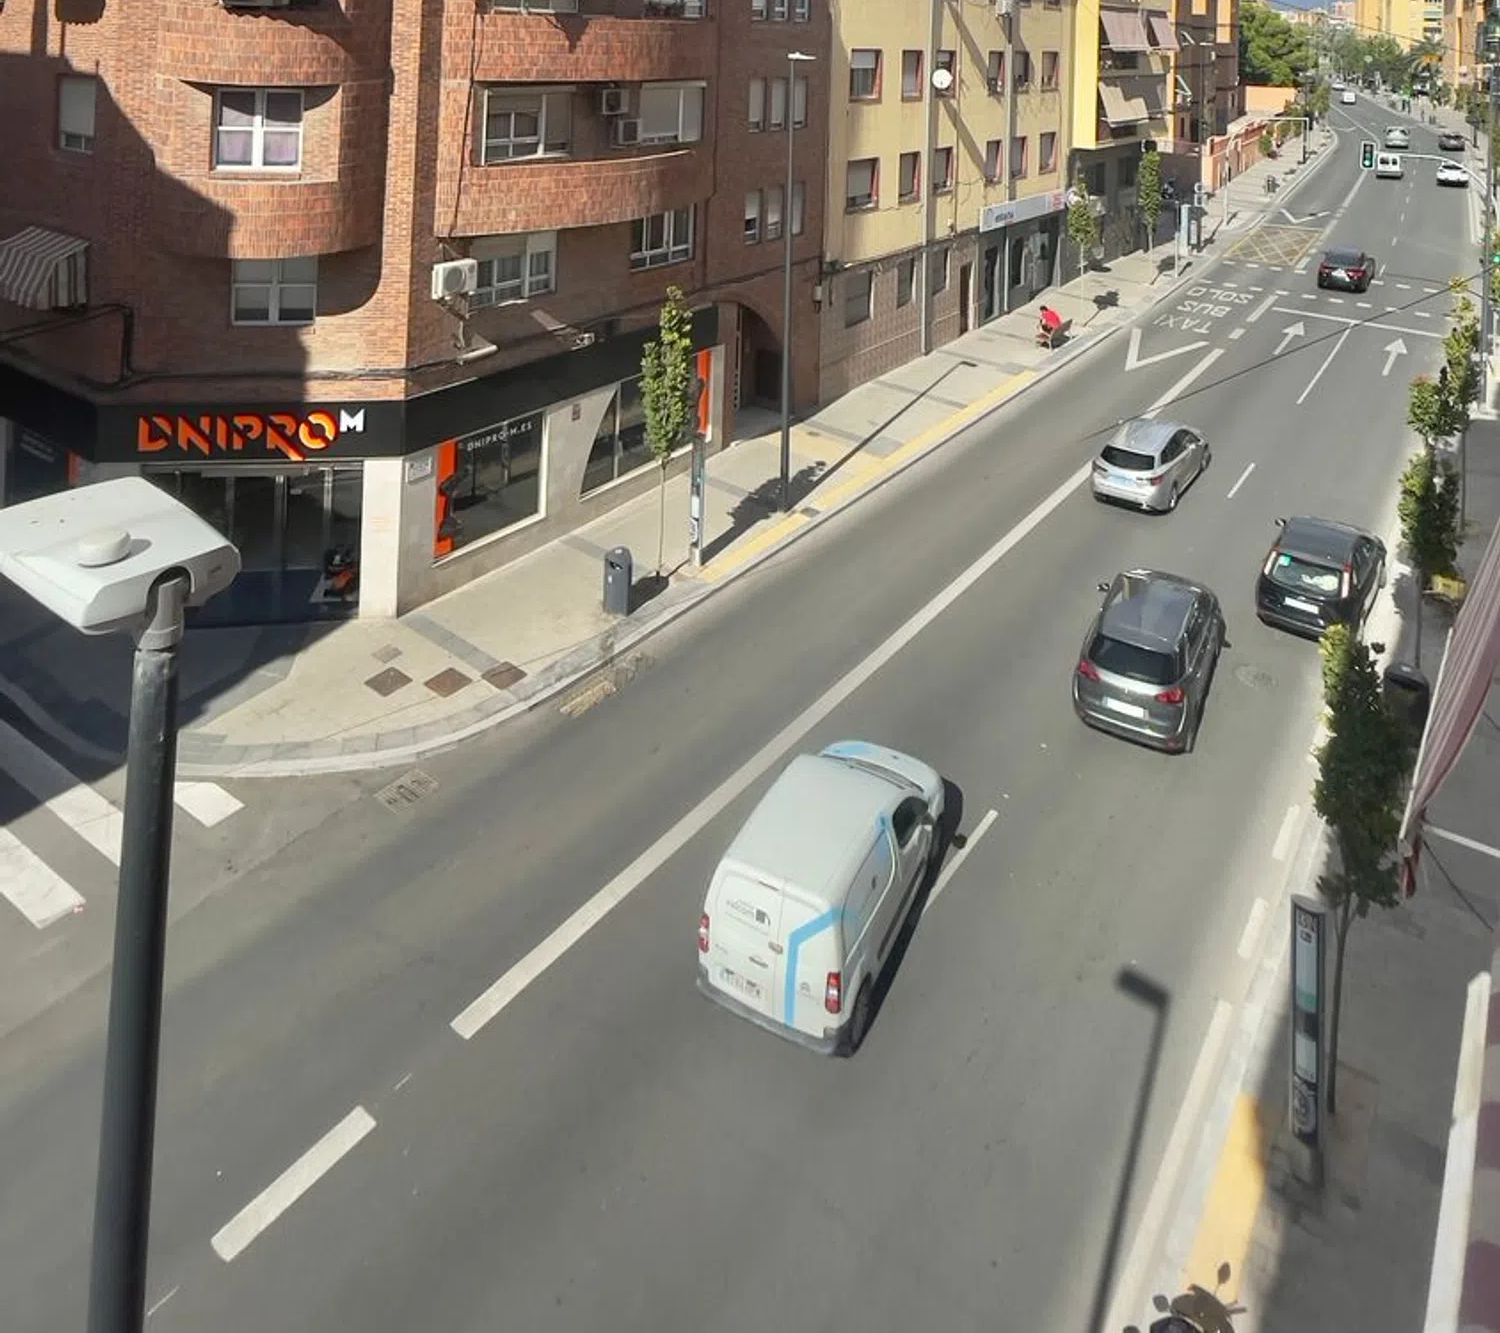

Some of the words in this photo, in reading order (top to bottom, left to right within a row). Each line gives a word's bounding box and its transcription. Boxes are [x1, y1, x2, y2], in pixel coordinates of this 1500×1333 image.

[1186, 286, 1254, 304] SOLO
[1177, 301, 1232, 317] BUS
[1153, 315, 1212, 333] TAXI
[137, 409, 338, 461] DNIPRO
[339, 408, 366, 433] M
